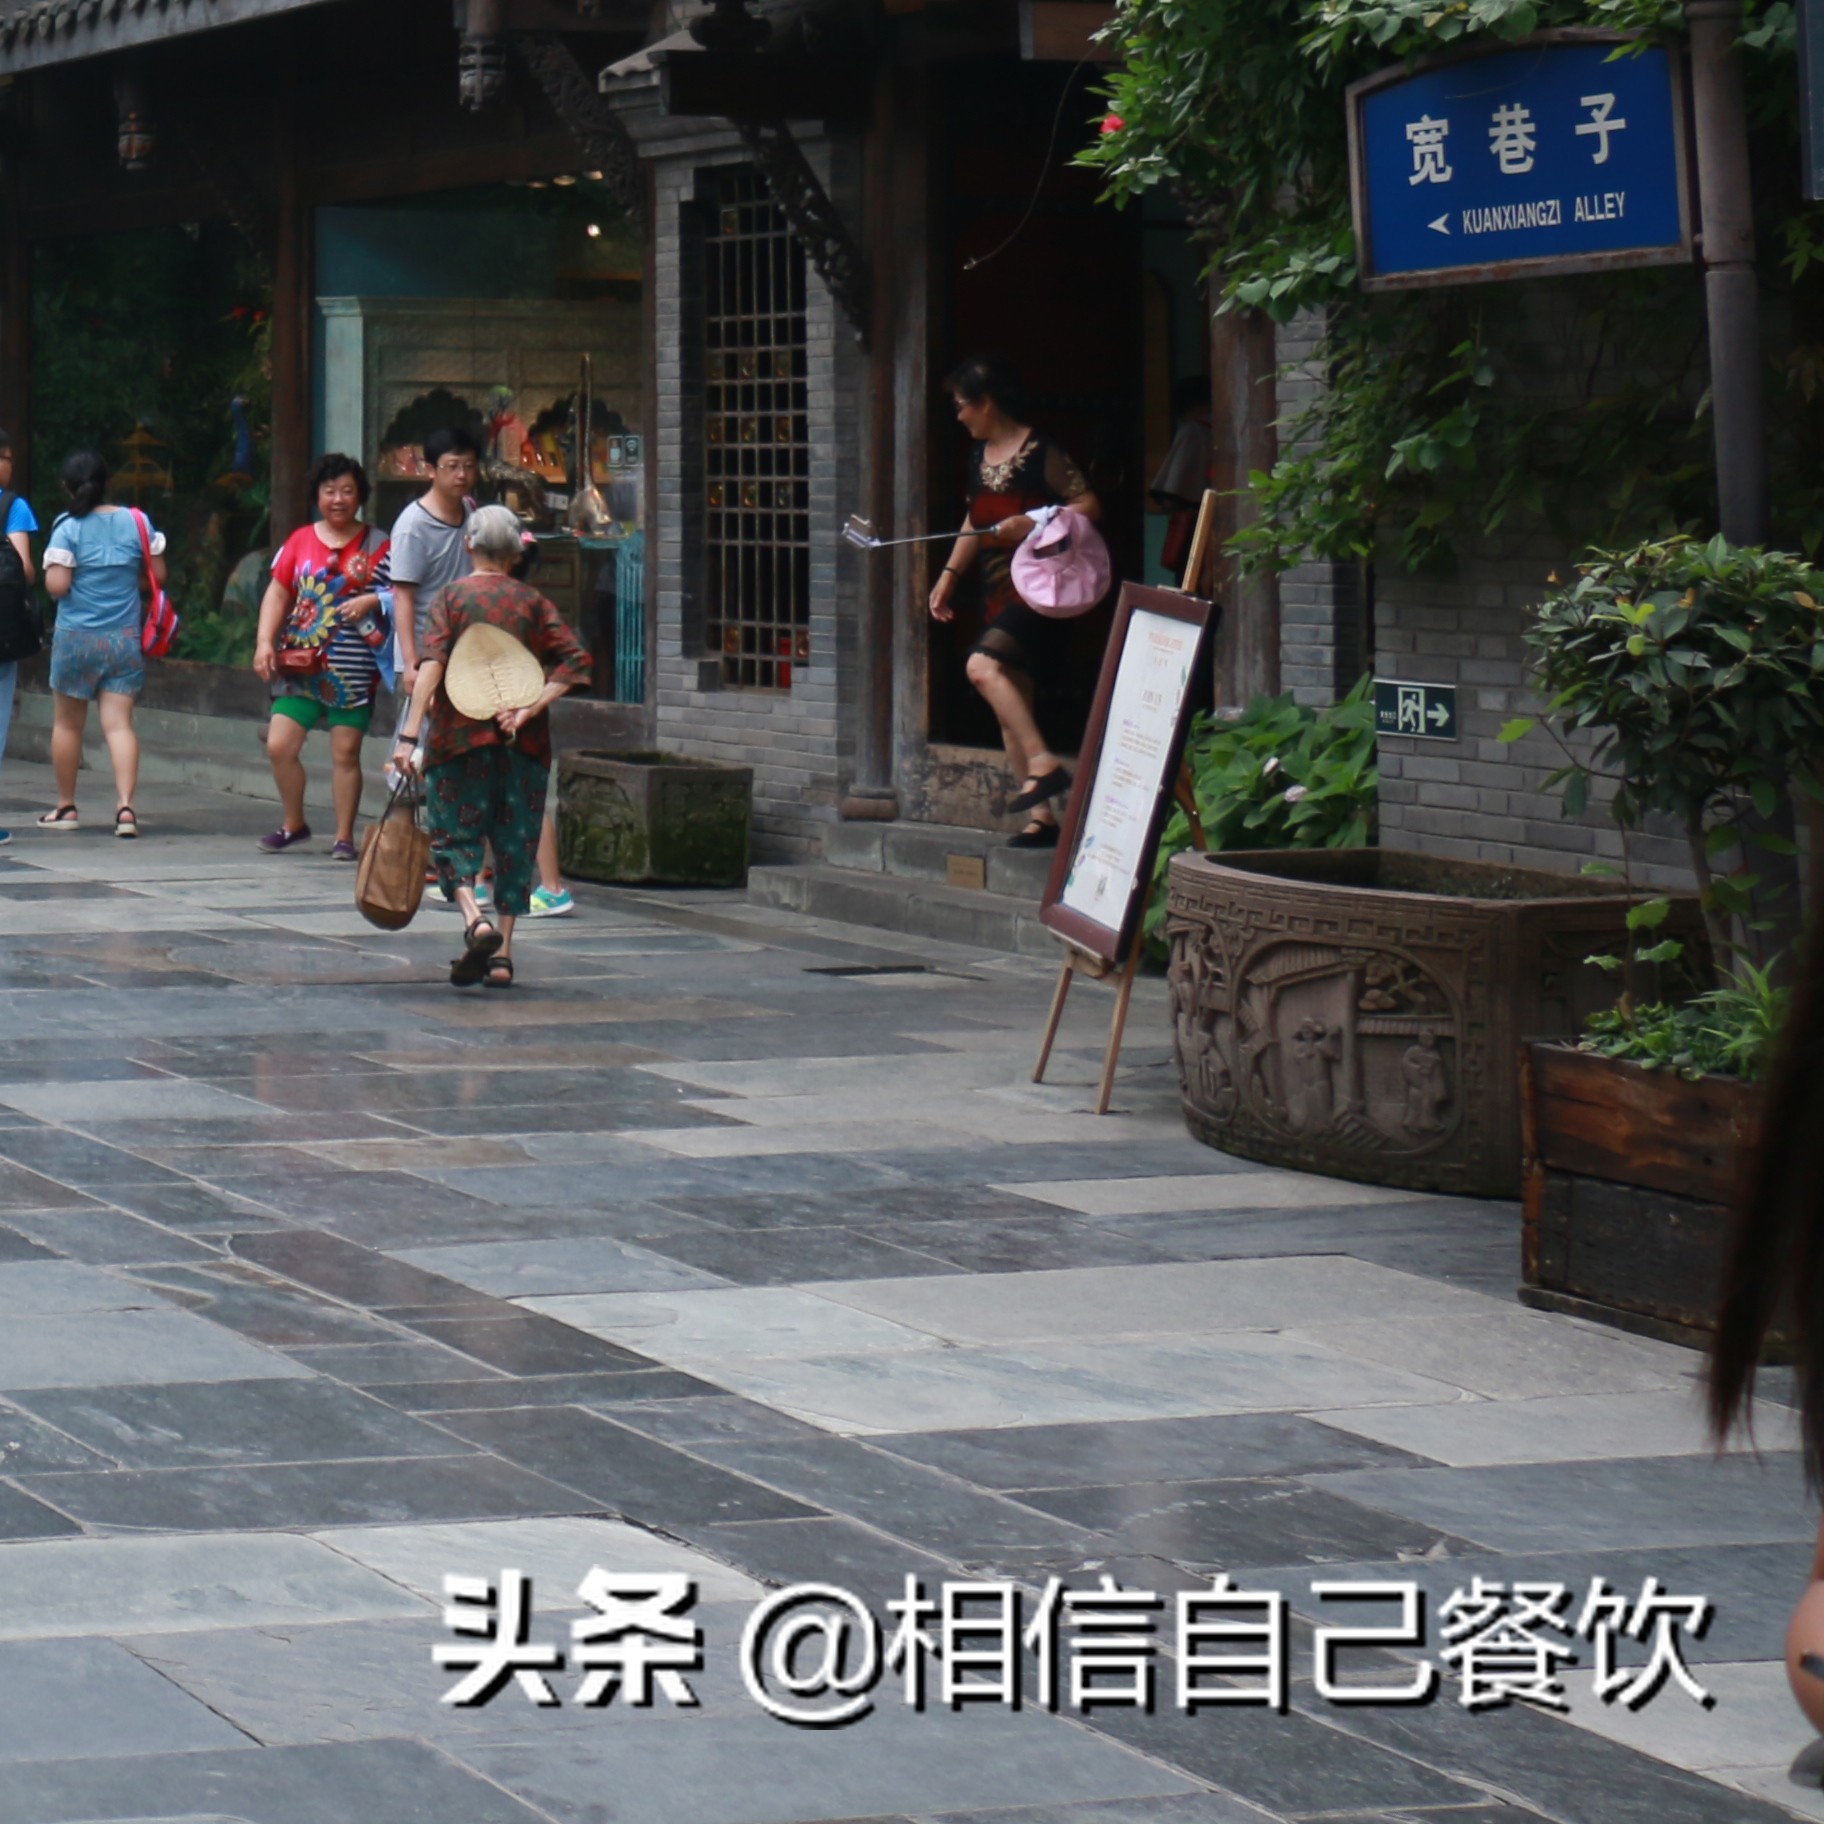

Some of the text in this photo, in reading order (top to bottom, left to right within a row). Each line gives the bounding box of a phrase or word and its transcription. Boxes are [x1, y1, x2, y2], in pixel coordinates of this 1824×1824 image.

[1406, 93, 1626, 186] 宽巷子
[1463, 191, 1625, 234] KUANXIANGZI ALLEY
